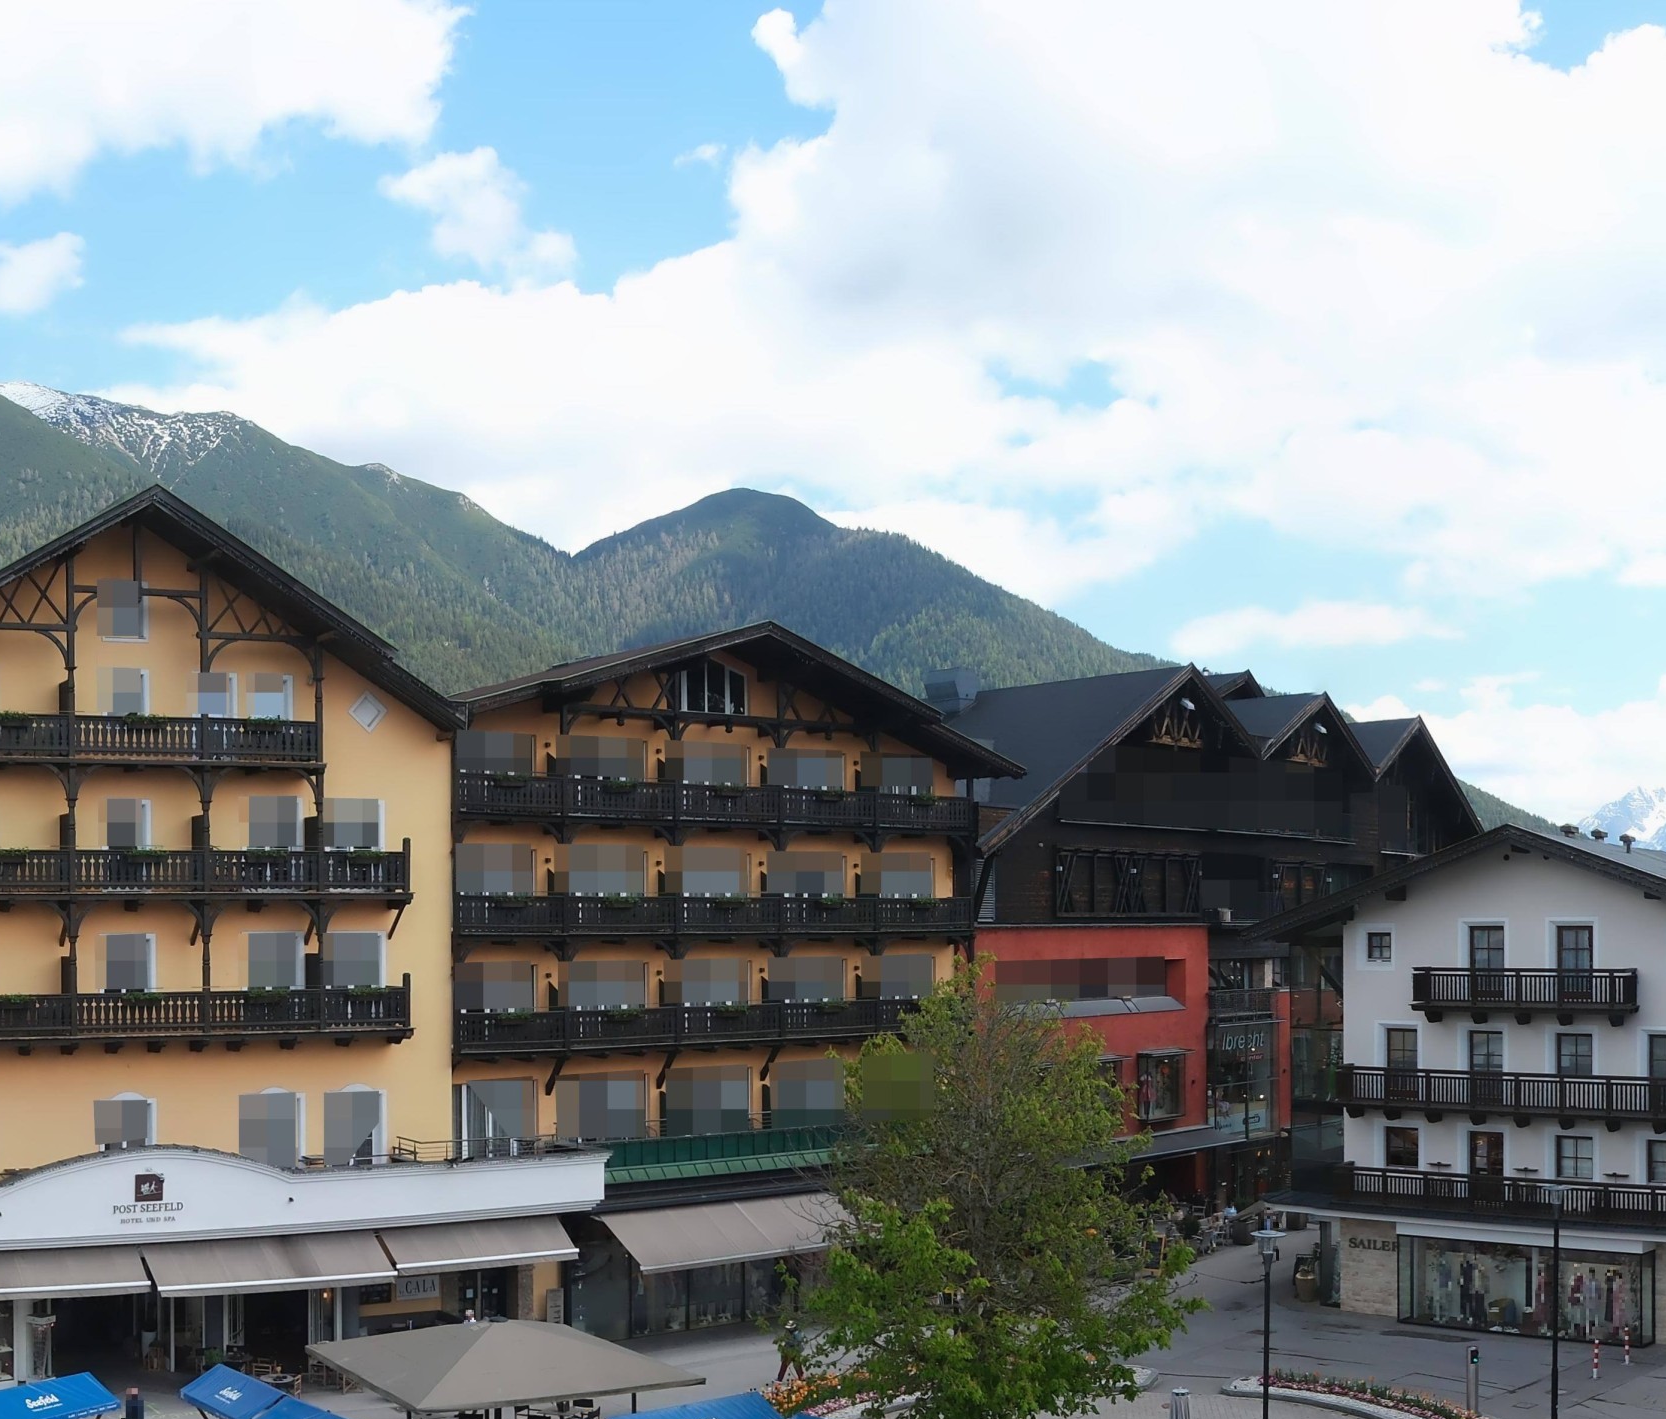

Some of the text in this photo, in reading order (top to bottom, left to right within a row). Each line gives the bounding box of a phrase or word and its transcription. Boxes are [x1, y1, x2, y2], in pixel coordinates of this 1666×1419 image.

[113, 1202, 184, 1214] POST SEEFELD
[218, 1386, 243, 1401] Seefeld
[25, 1393, 60, 1410] Seefeld
